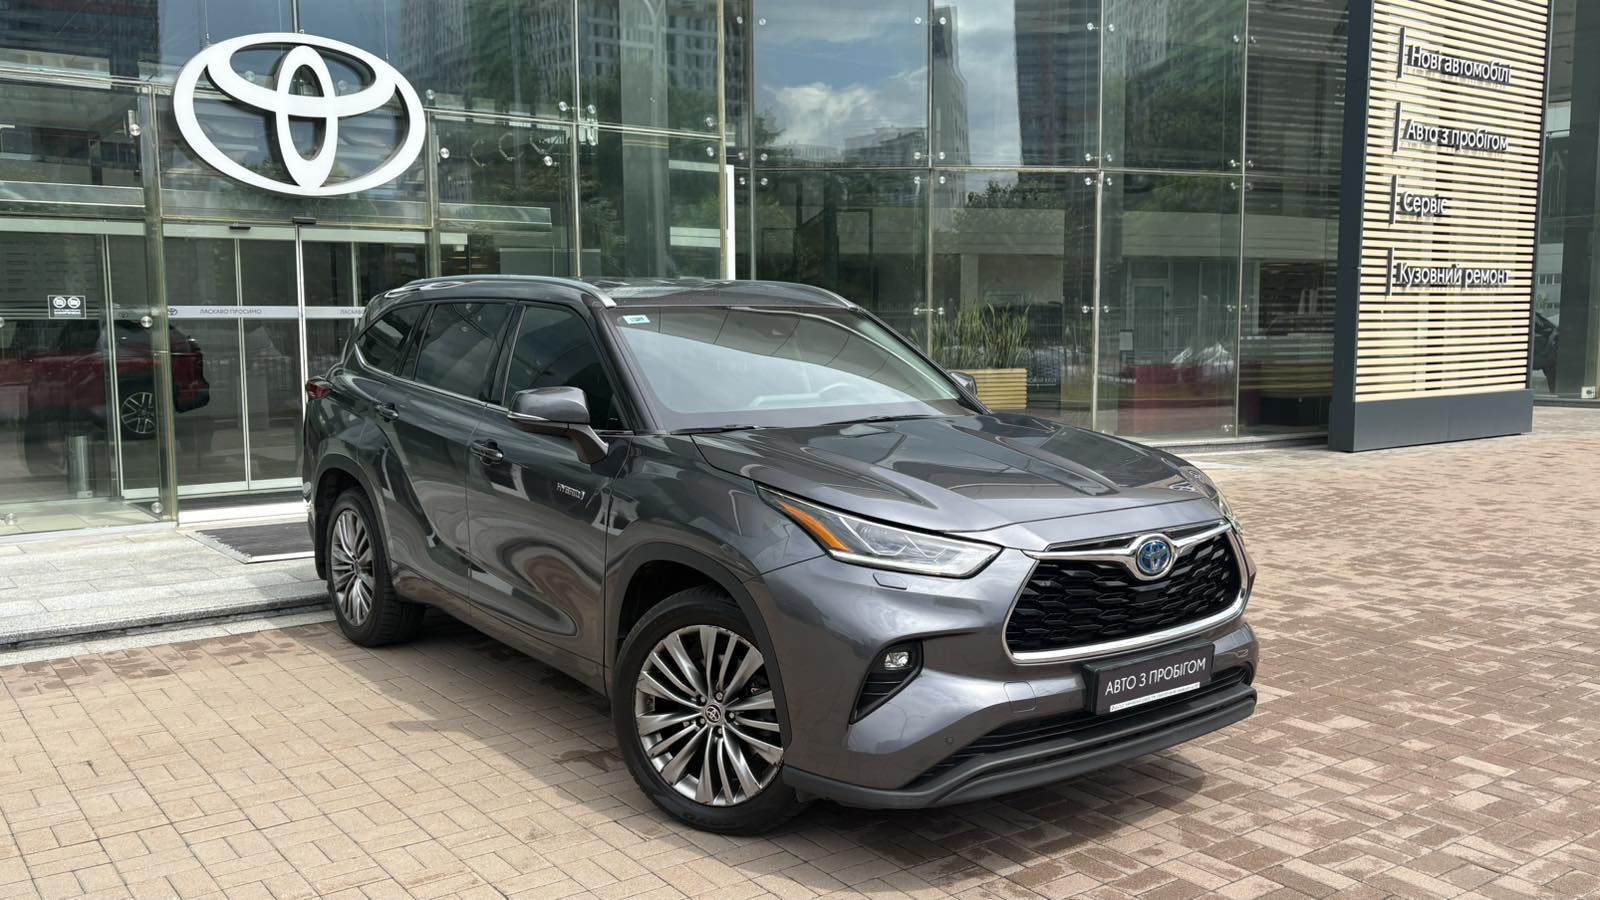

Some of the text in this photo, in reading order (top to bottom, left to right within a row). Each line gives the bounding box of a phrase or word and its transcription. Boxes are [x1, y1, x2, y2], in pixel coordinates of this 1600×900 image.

[1406, 120, 1509, 151] Авто з пробігом
[1403, 191, 1448, 216] Сервіс
[1400, 262, 1511, 288] Кузовний ремонт
[1105, 675, 1136, 696] АВТО
[1149, 657, 1206, 684] ПРОБІГОМ
